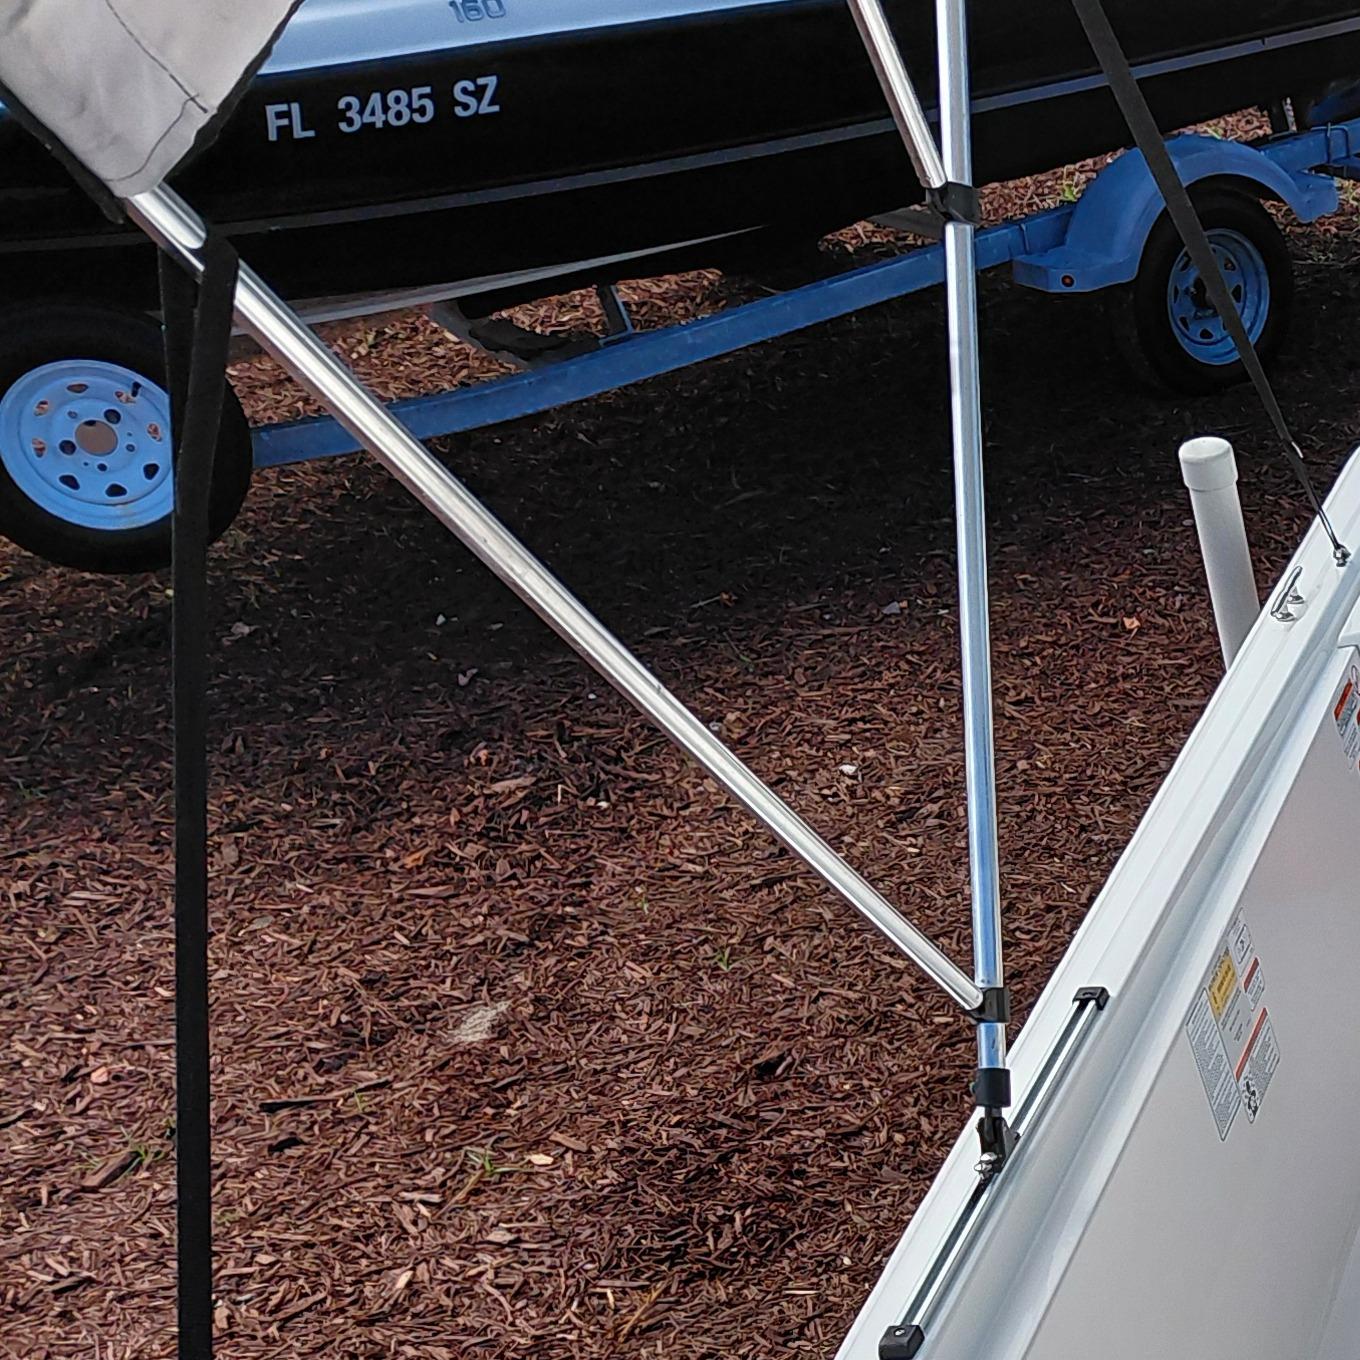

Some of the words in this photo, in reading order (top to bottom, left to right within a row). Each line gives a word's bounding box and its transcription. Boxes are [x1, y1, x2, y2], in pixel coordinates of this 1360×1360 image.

[265, 102, 315, 141] FL
[337, 86, 434, 133] 3485
[453, 75, 500, 118] SZ
